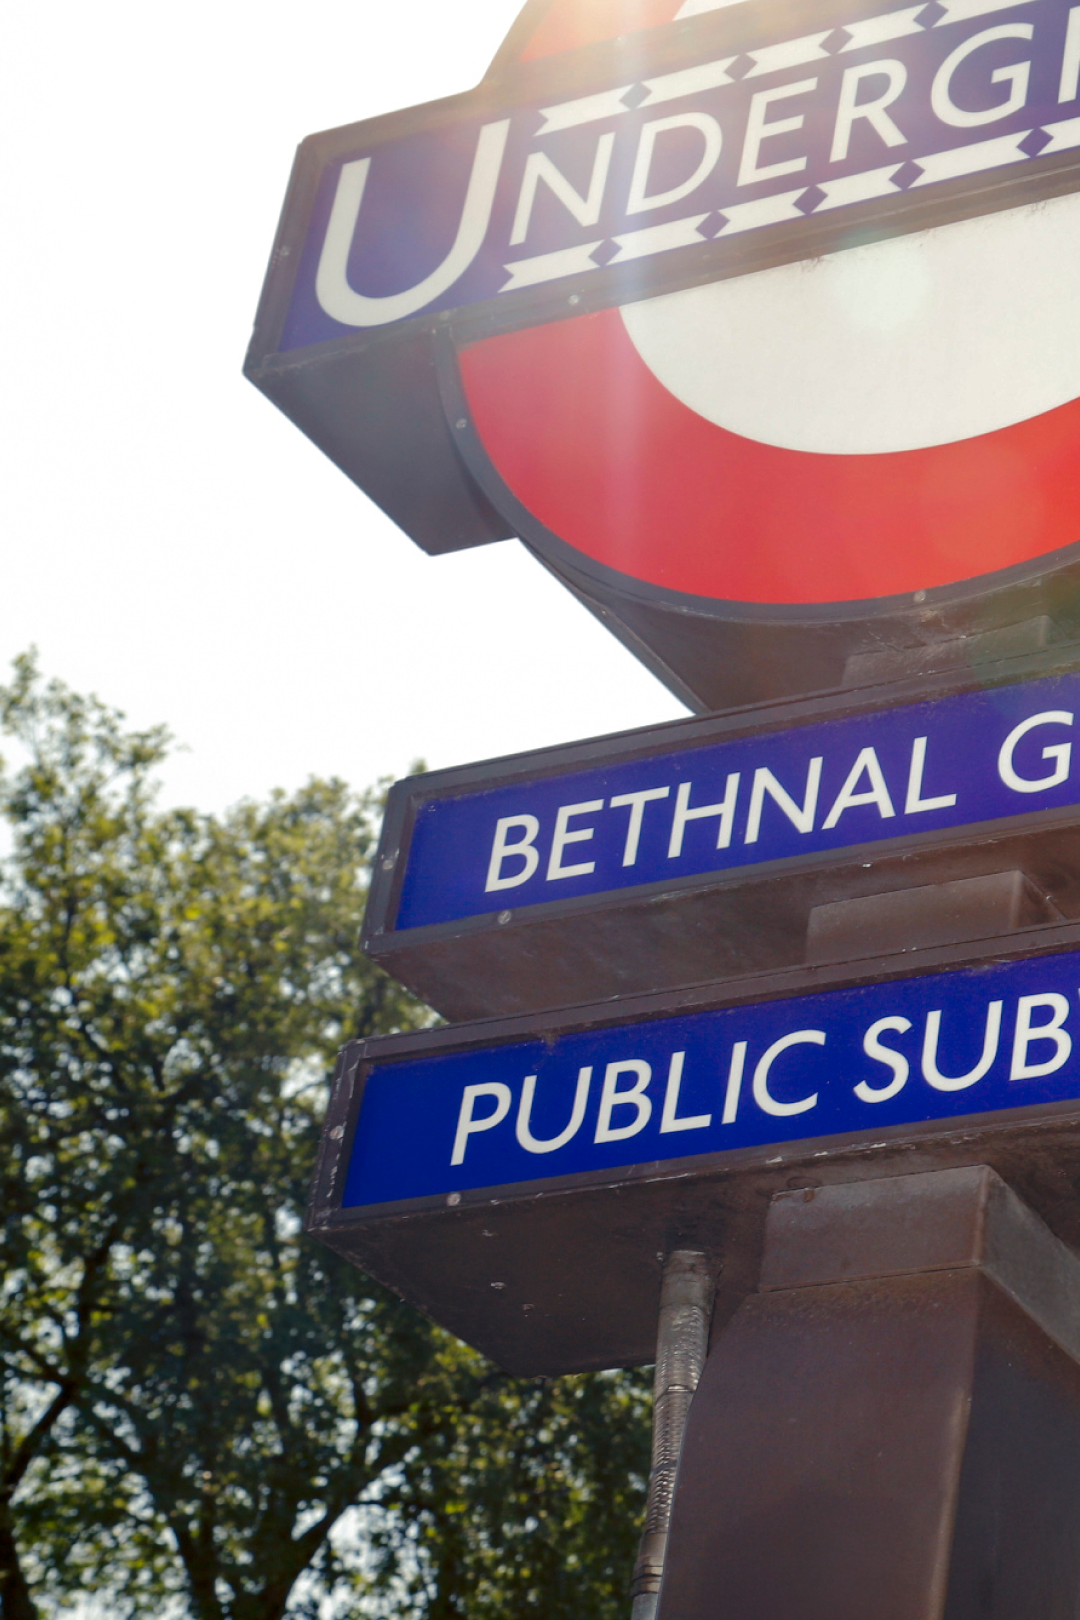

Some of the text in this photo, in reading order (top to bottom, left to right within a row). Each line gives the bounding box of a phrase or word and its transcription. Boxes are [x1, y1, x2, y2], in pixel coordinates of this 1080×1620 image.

[483, 736, 957, 893] BETHNAL
[450, 986, 1080, 1166] PUBLIC SUB
